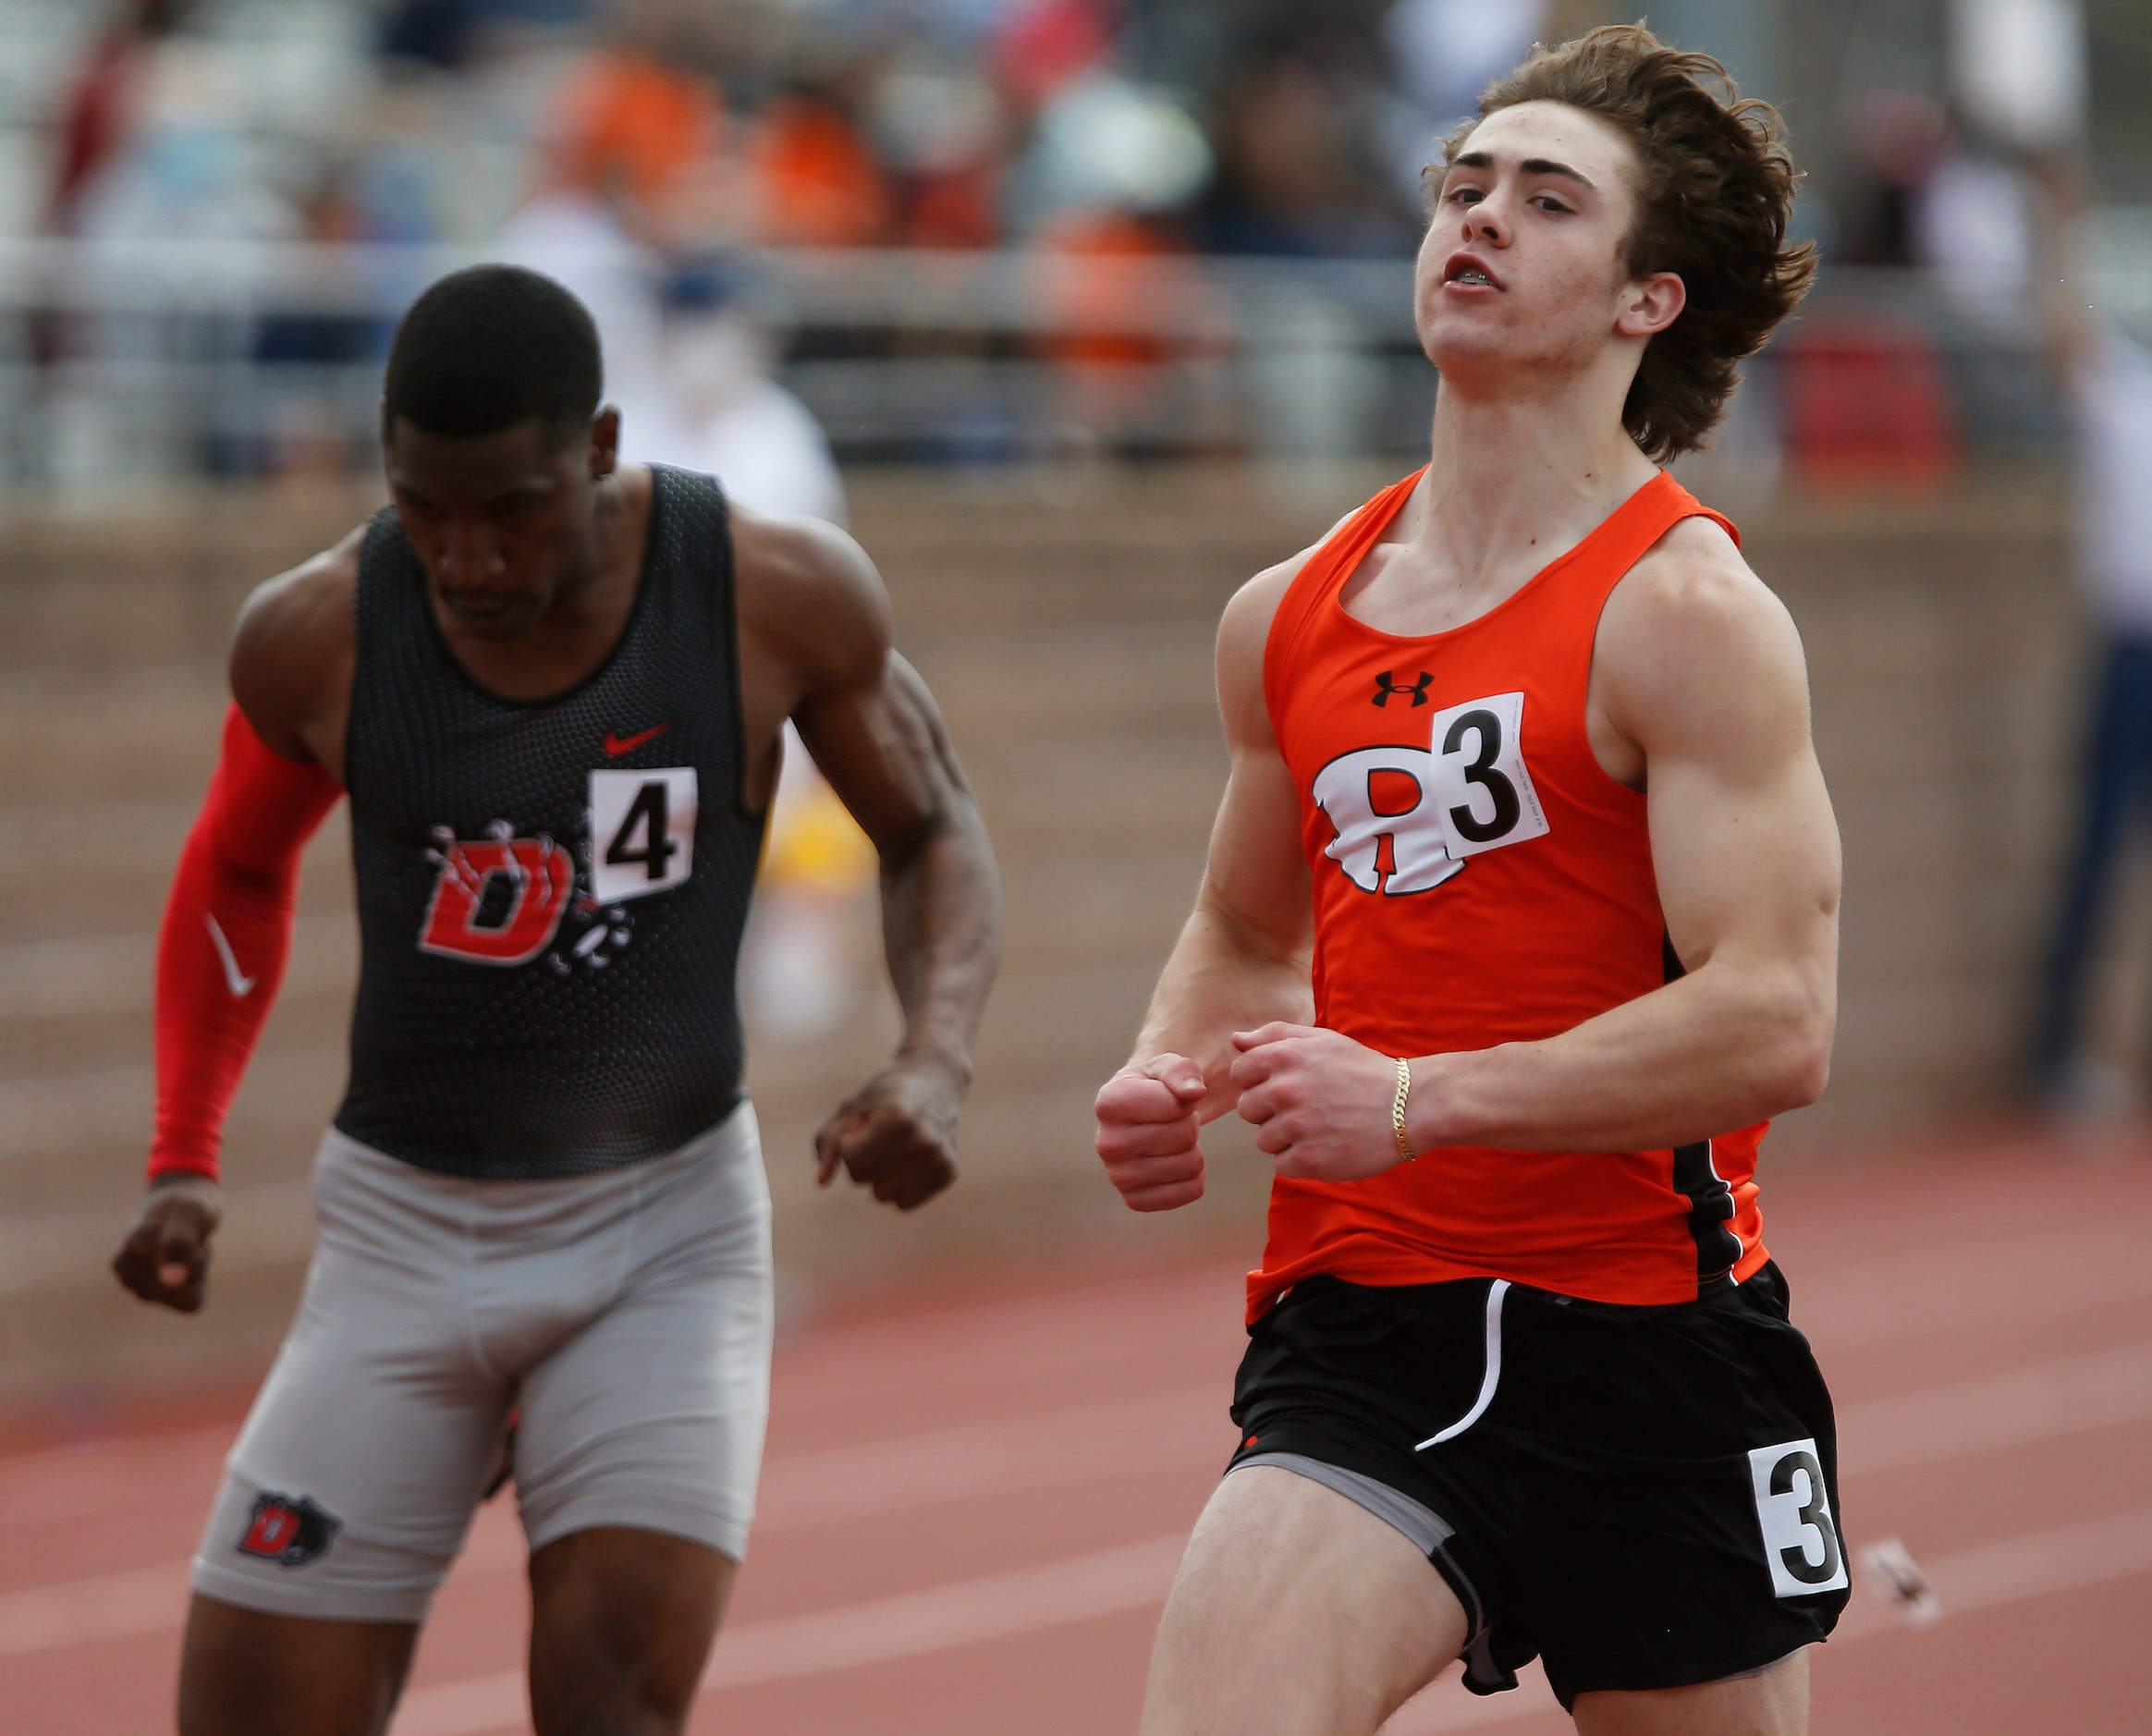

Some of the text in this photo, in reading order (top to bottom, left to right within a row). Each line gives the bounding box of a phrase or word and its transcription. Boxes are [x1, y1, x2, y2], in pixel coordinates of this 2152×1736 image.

[605, 781, 676, 880] 4
[1312, 744, 1467, 897] R
[1442, 709, 1521, 842] 3
[417, 837, 575, 968] D
[238, 1503, 301, 1558] D
[1770, 1450, 1841, 1583] 3
